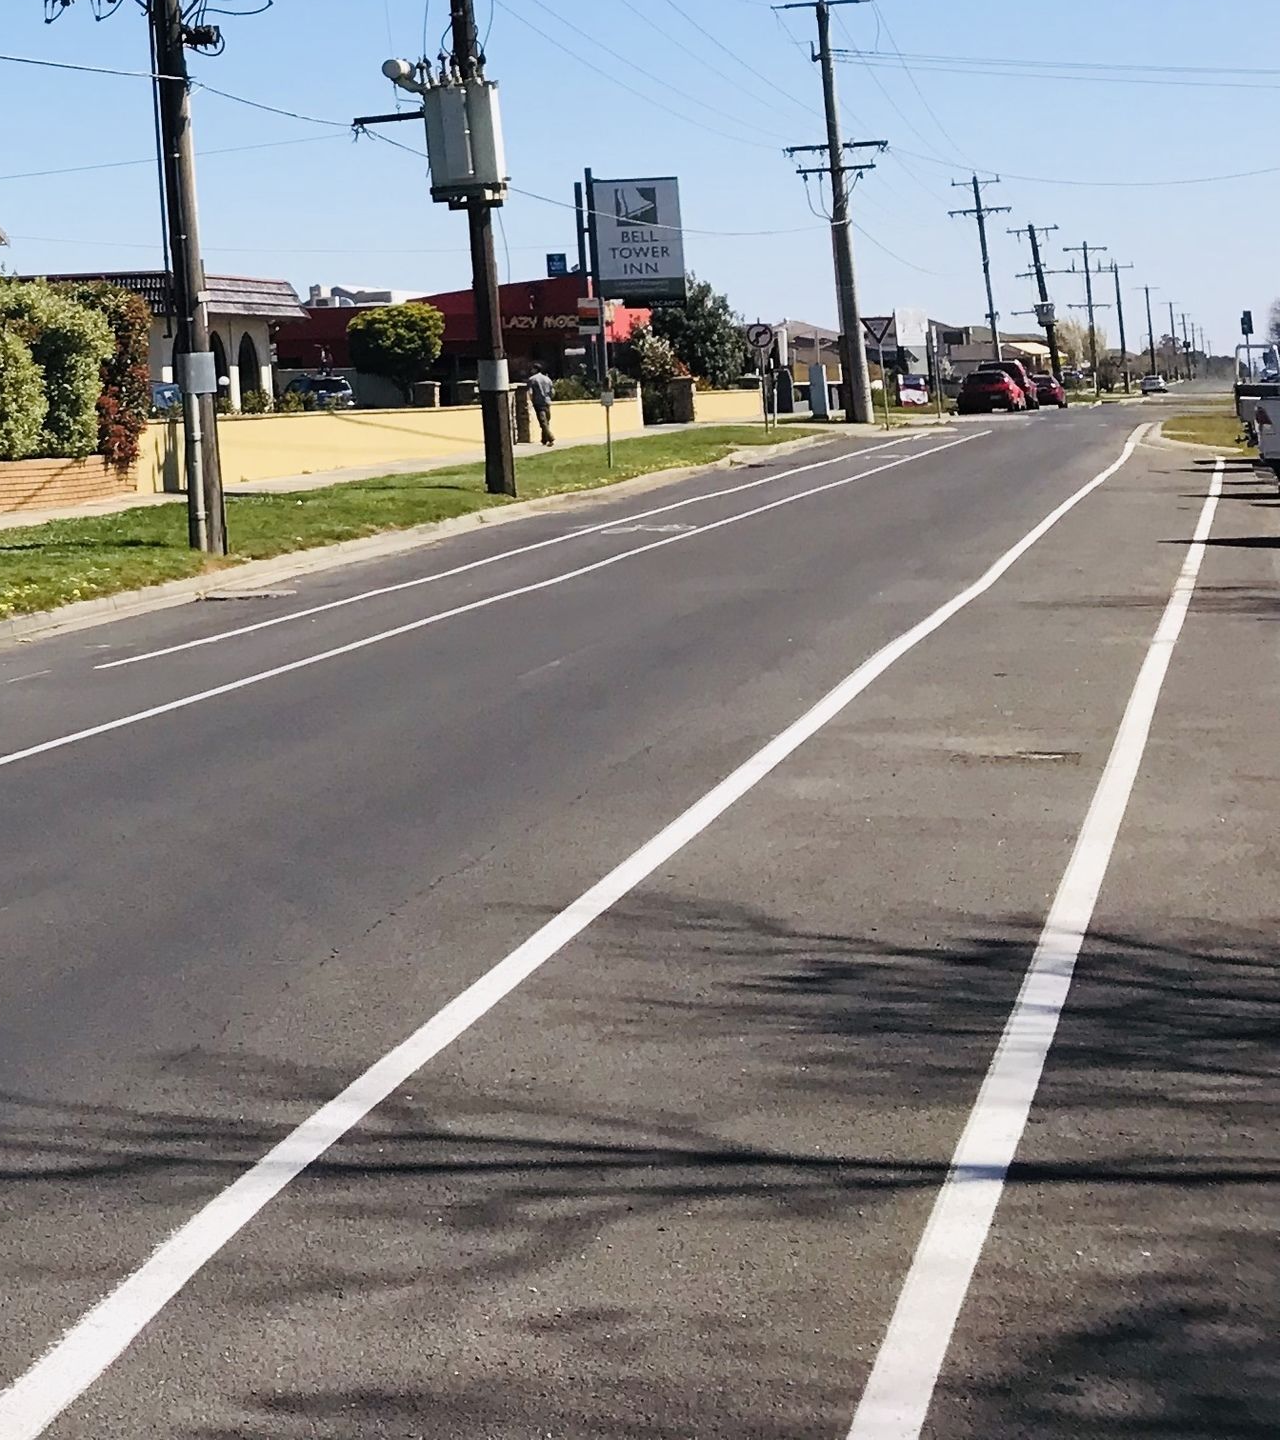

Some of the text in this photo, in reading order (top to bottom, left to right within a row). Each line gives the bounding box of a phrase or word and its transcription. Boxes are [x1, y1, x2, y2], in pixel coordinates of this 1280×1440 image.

[621, 230, 660, 243] BELL
[609, 245, 670, 259] TOWER
[623, 262, 660, 275] INN
[501, 315, 538, 329] LAZY
